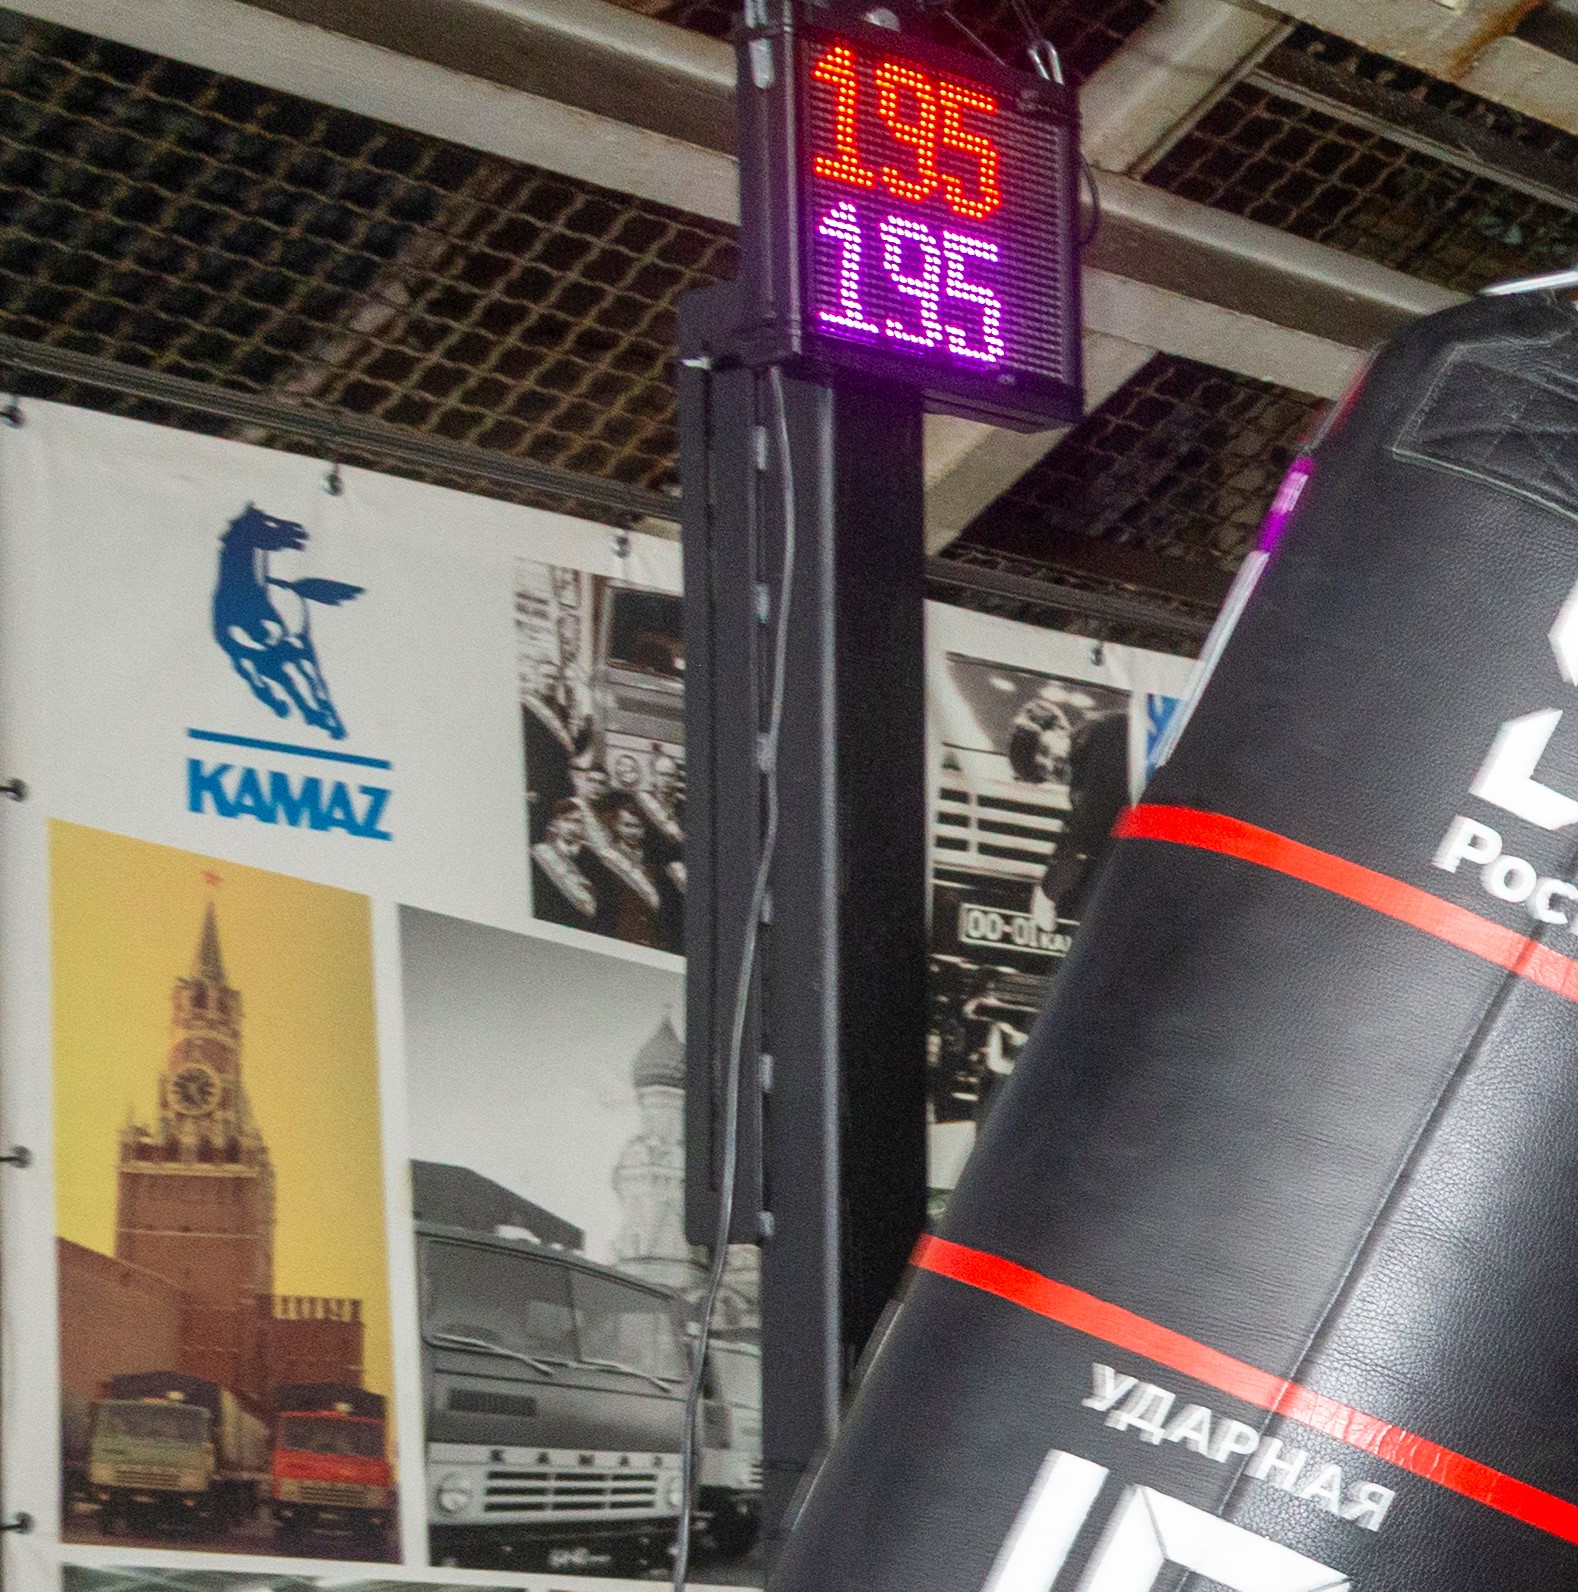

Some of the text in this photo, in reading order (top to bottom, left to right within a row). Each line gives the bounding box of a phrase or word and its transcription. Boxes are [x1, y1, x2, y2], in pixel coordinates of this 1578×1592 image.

[813, 46, 1001, 219] 195
[819, 201, 1004, 362] 195
[186, 757, 392, 843] KAMAZ
[1082, 1362, 1396, 1533] УДАРНАЯ
